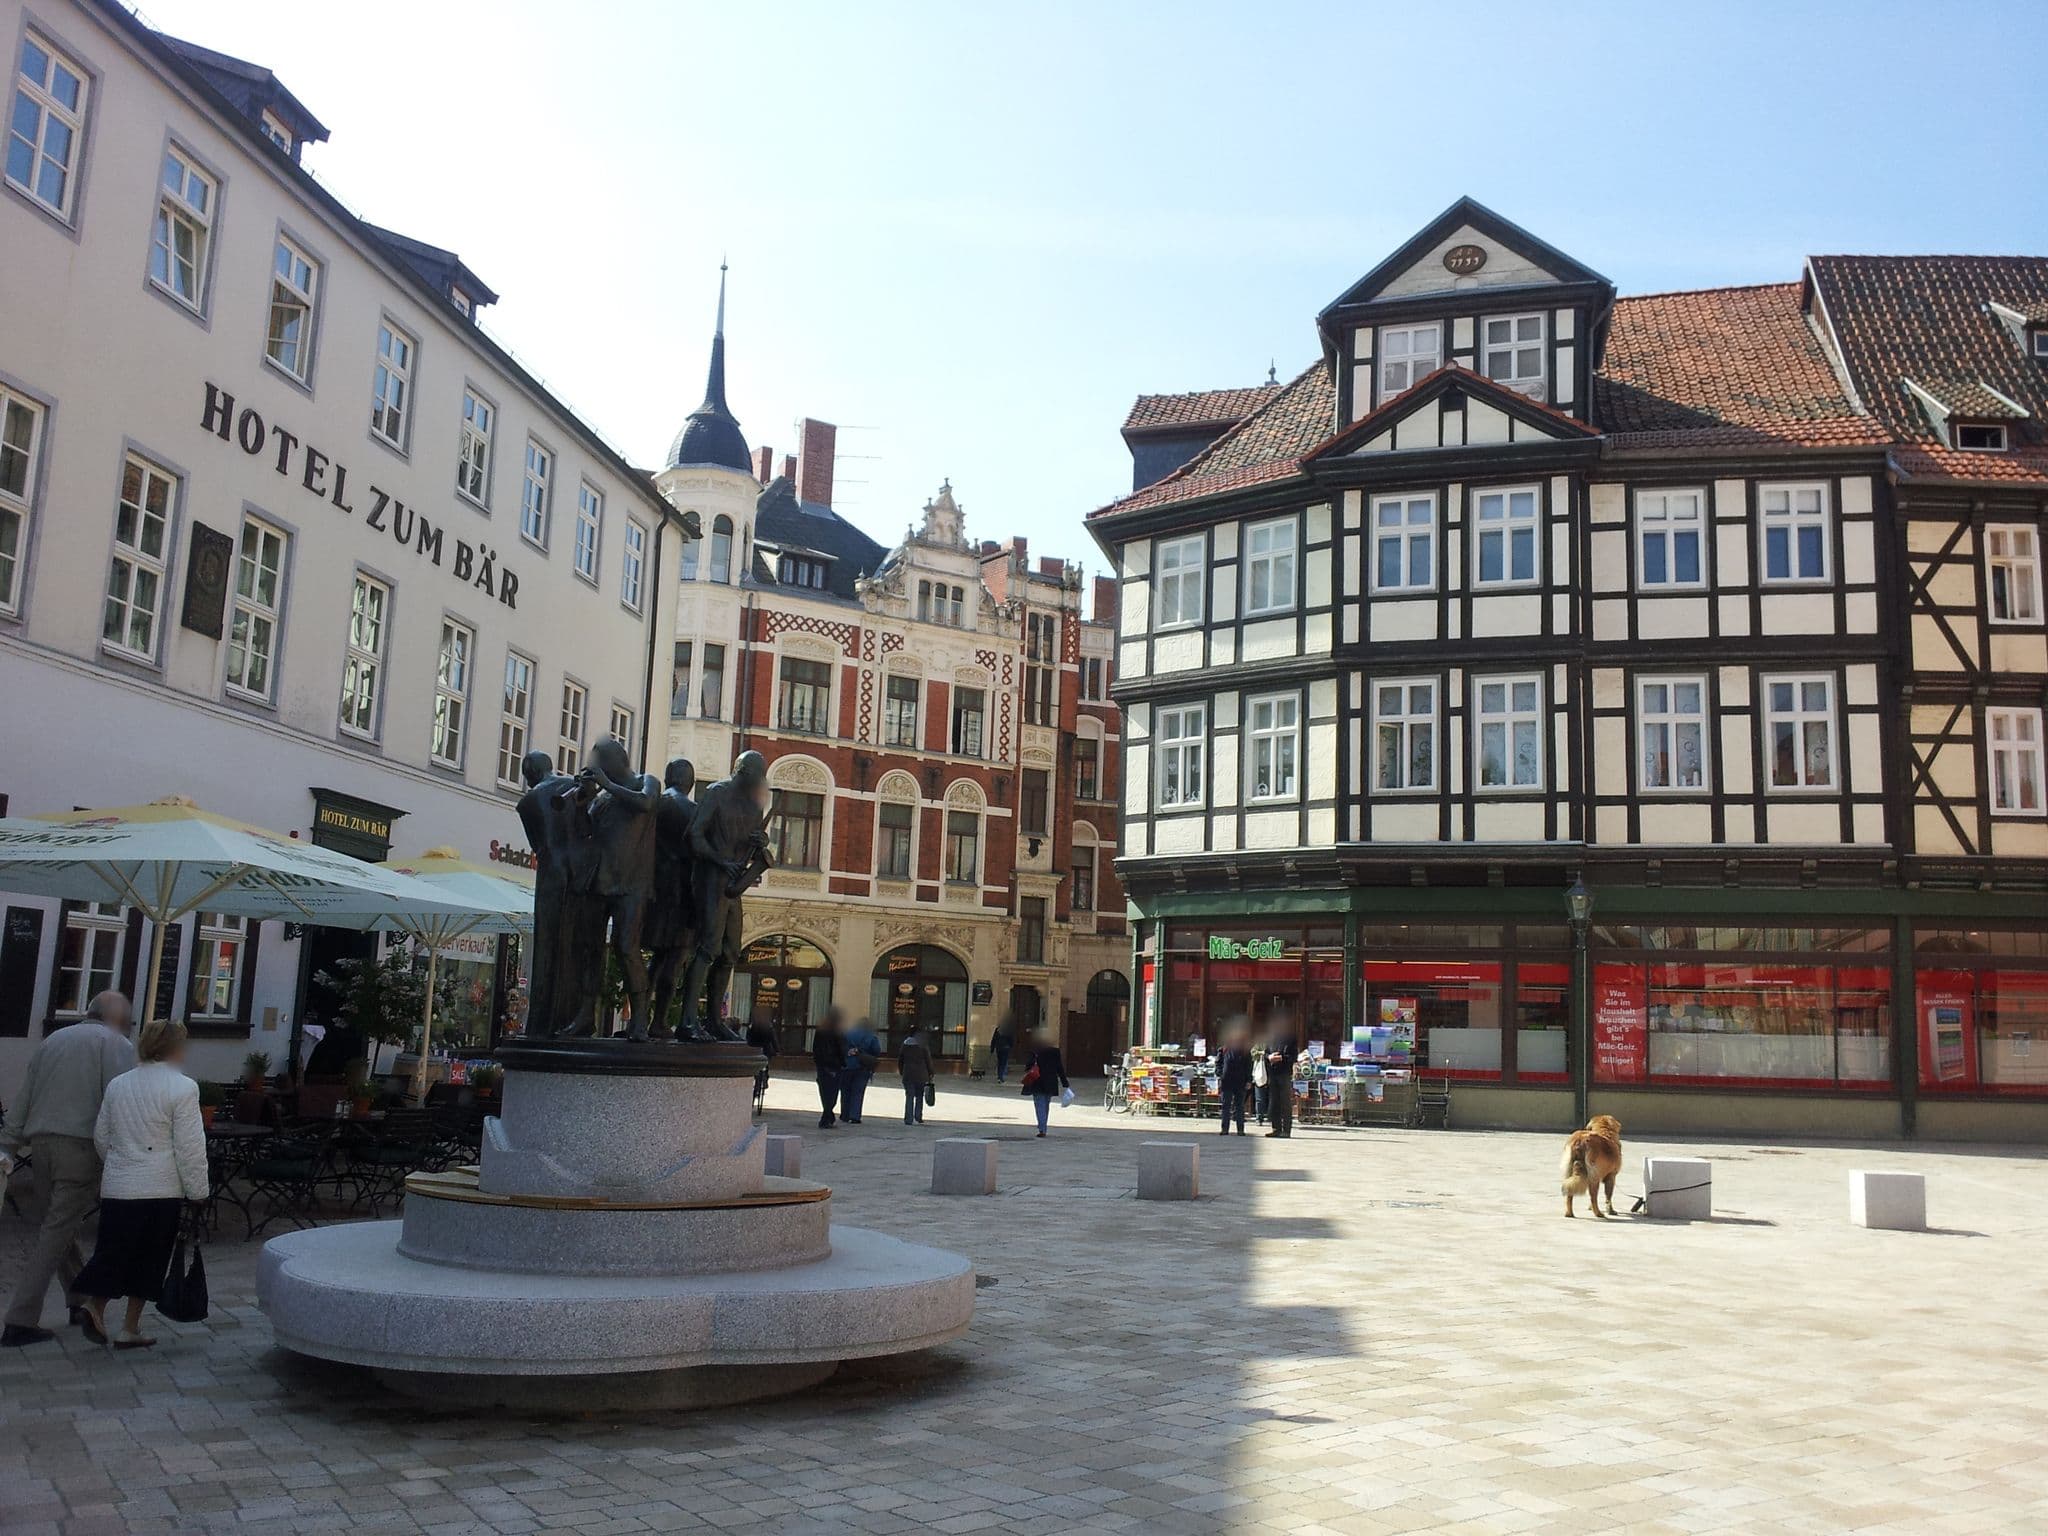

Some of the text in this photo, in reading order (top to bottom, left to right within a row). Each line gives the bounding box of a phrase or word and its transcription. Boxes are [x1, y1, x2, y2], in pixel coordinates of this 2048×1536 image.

[200, 381, 519, 610] HOTEL ZUM BÄR
[320, 808, 388, 838] HOTEL ZUM BÄR
[1209, 935, 1283, 960] Mäc-Geiz
[1605, 998, 1631, 1006] Sie im
[1600, 1007, 1636, 1015] Haushalt
[1598, 1016, 1637, 1024] brauchen
[451, 1070, 465, 1080] SALE
